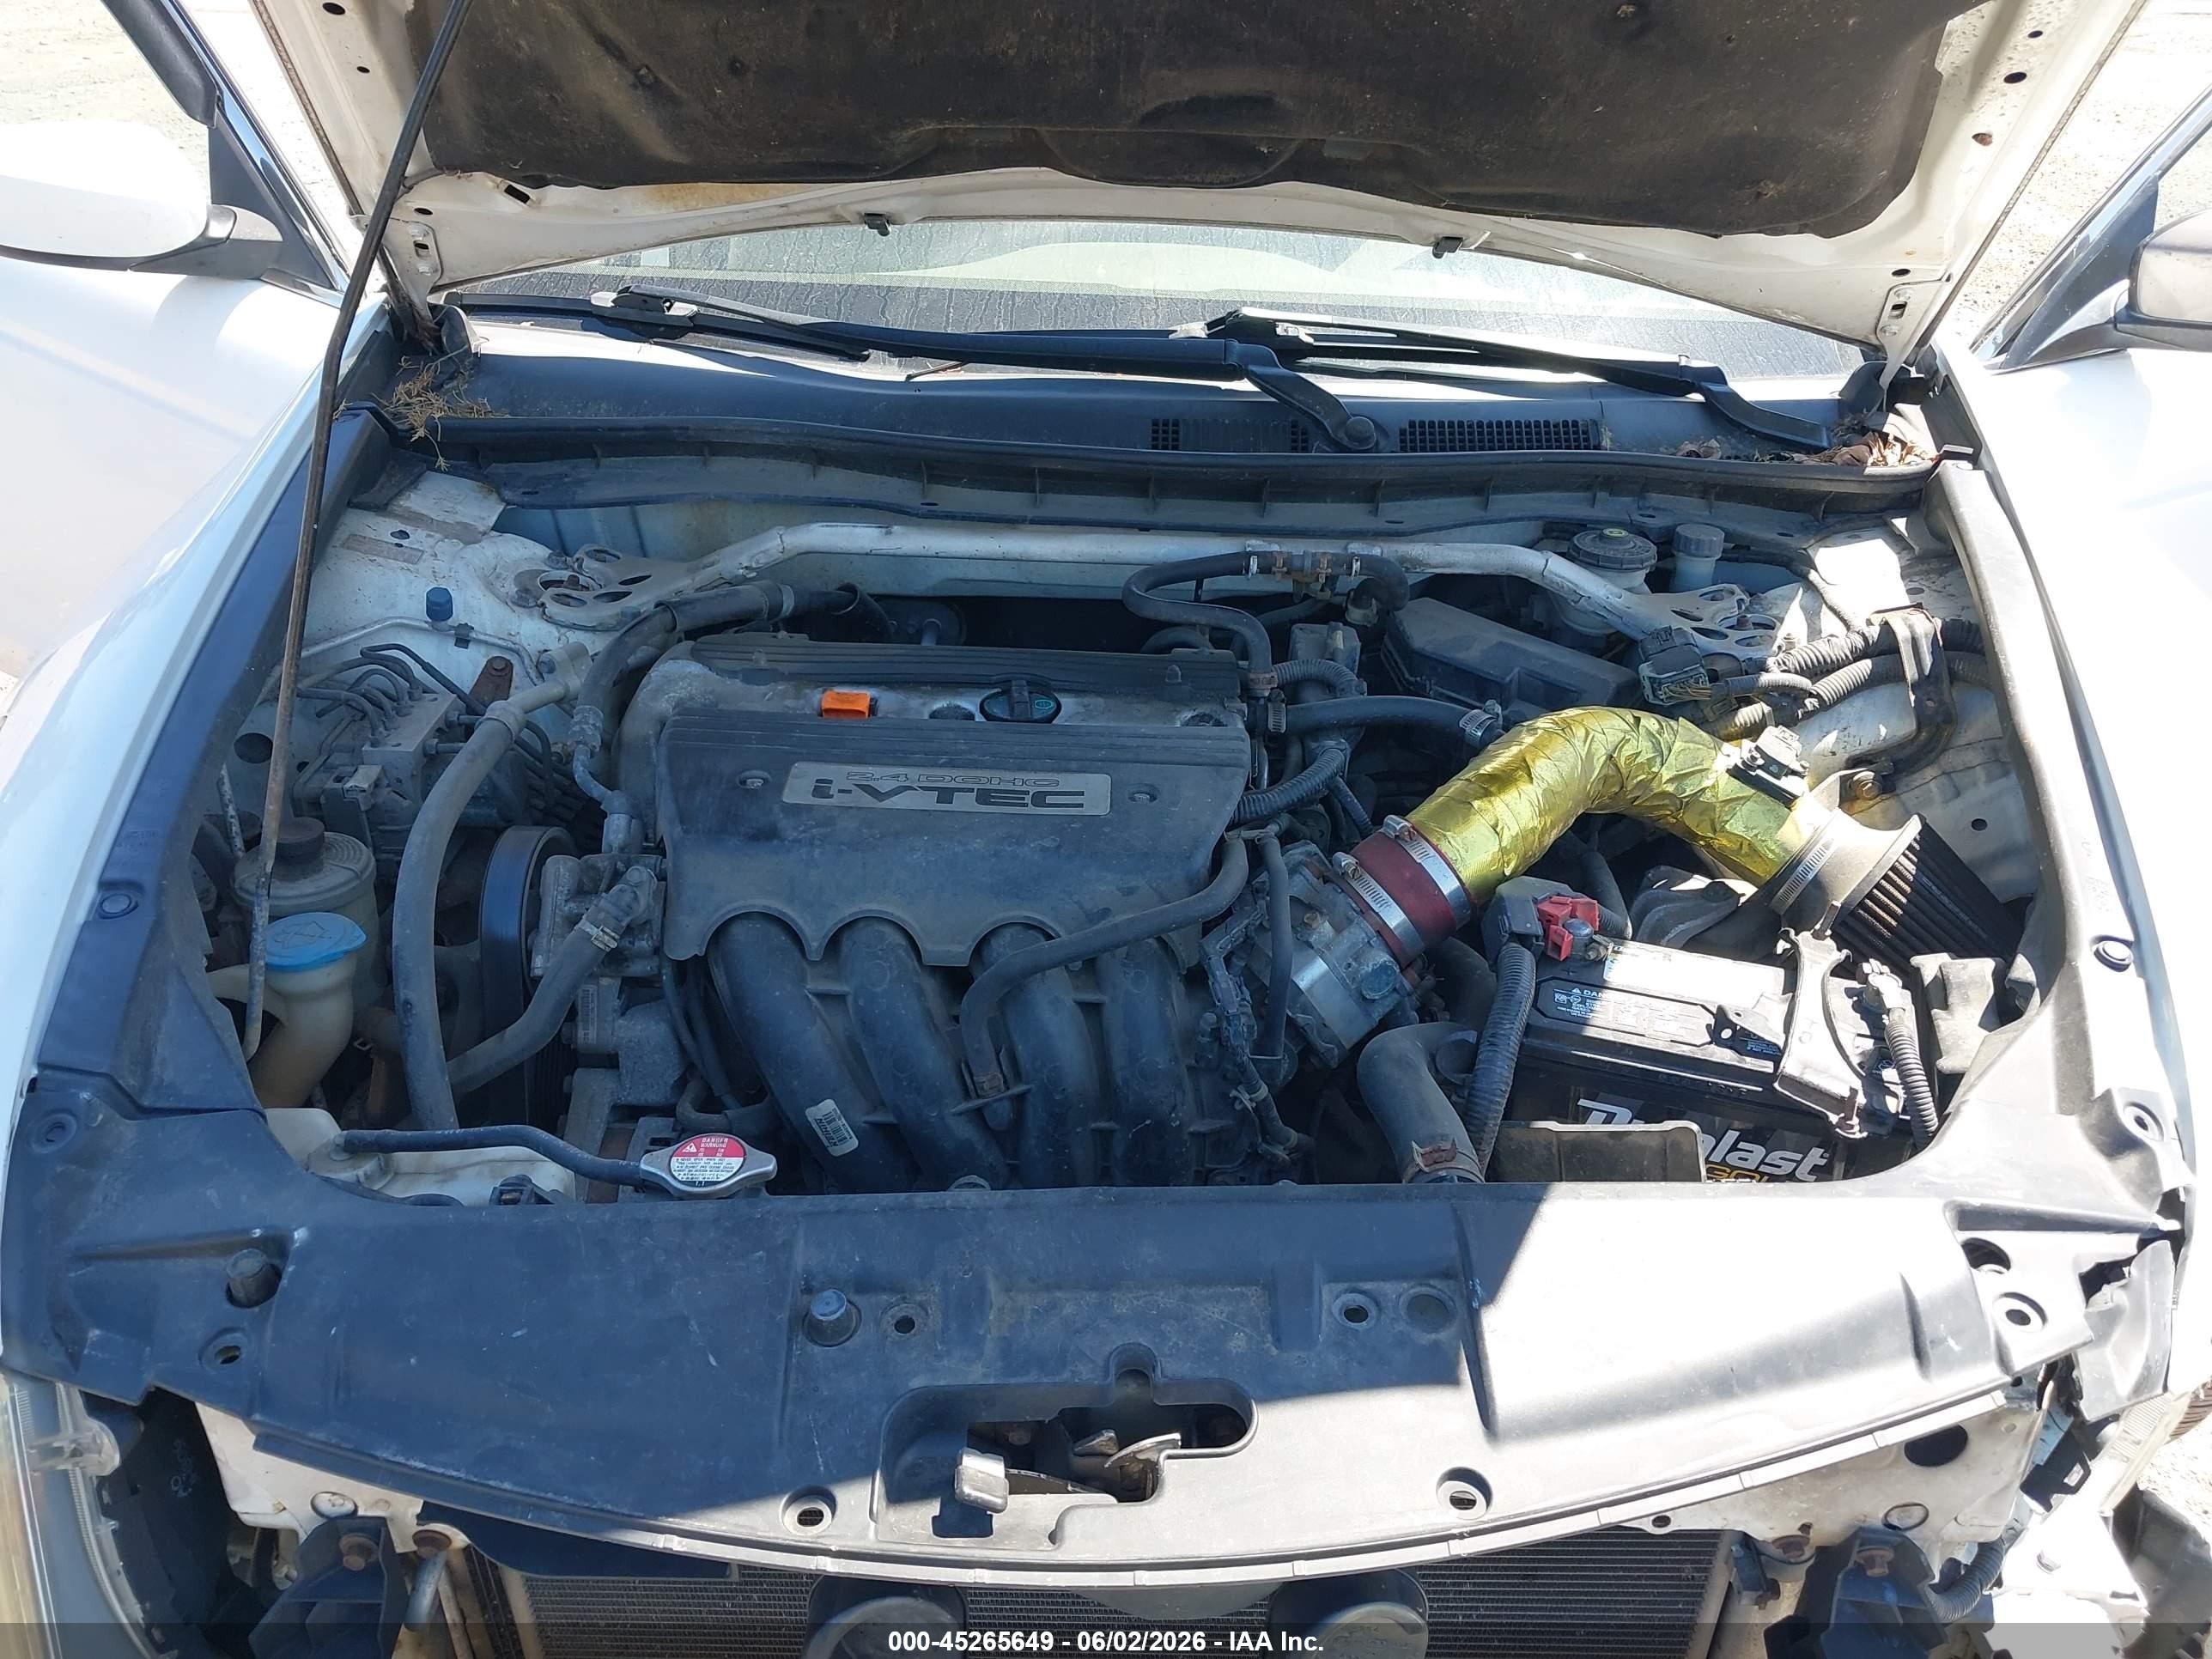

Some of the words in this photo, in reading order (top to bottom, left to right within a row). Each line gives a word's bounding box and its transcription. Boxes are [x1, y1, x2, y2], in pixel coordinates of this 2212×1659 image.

[846, 772, 908, 782] 2.4
[918, 775, 1060, 787] DOHC
[811, 778, 1086, 809] i-VTEC
